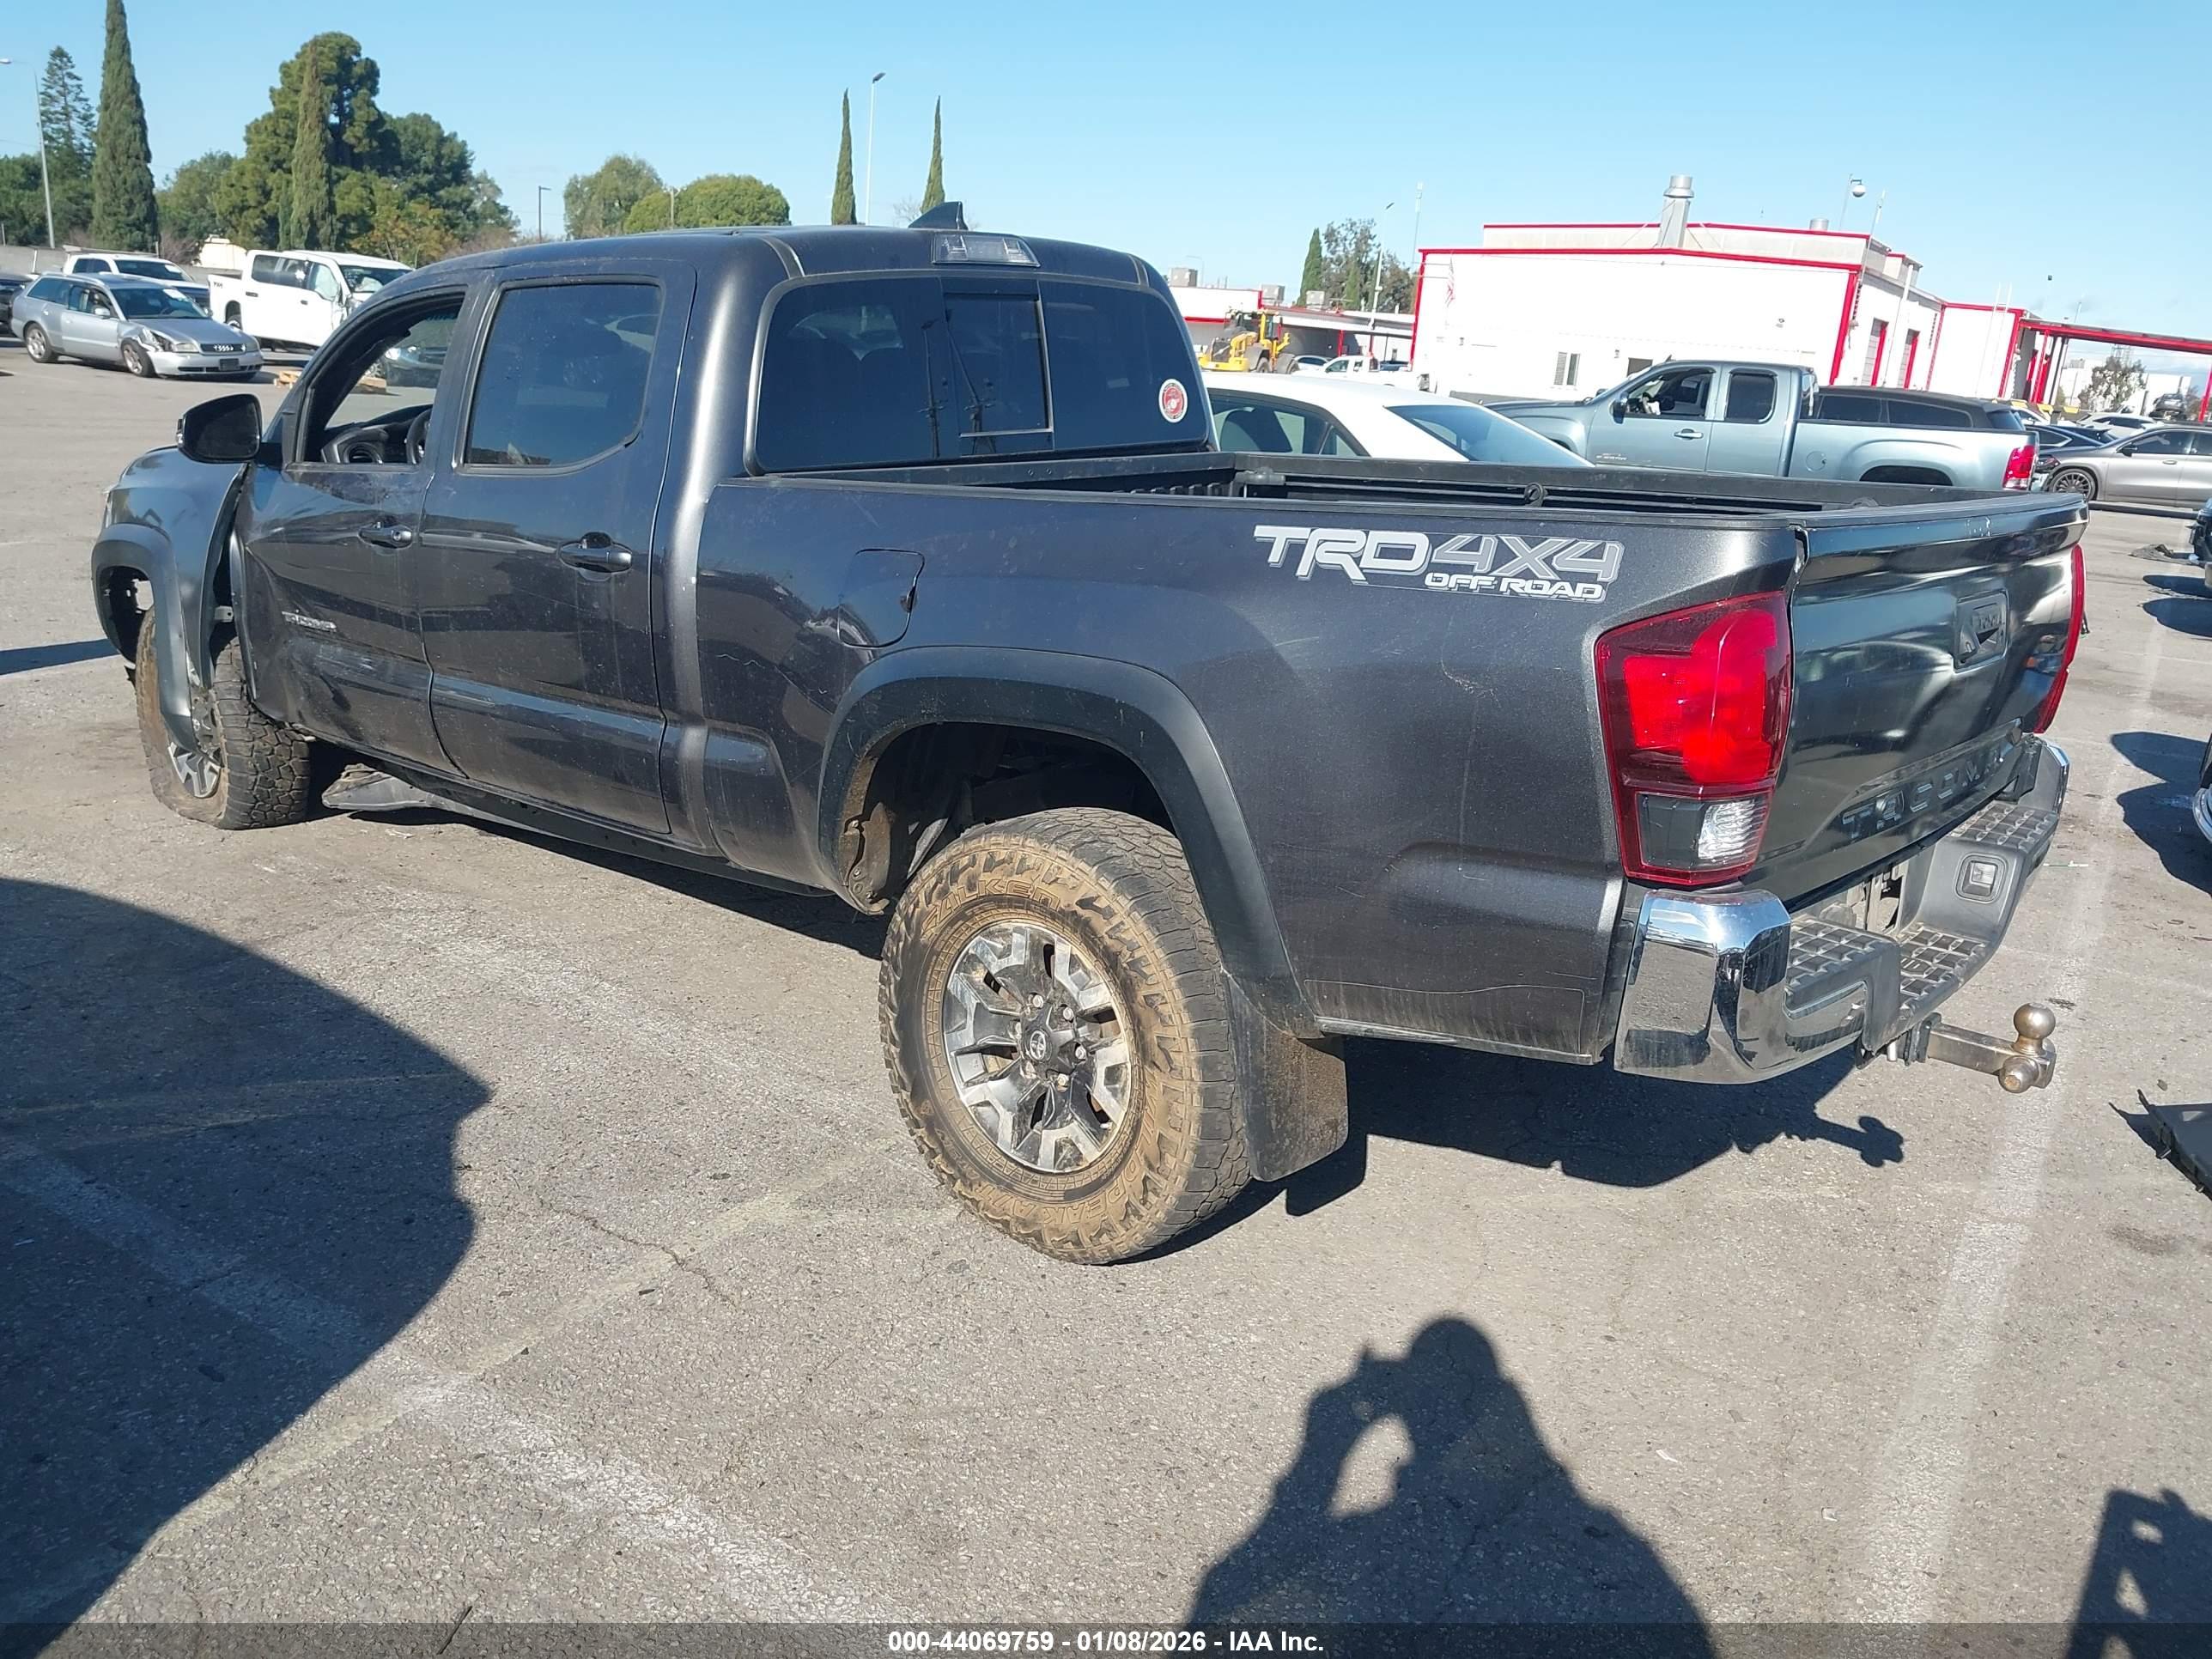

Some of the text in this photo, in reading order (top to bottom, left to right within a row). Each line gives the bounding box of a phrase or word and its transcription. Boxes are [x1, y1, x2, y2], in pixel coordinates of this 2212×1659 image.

[1253, 525, 1625, 585] TRD 4X4
[1424, 573, 1606, 601] OFF ROAD
[921, 878, 1061, 938] FALKEN
